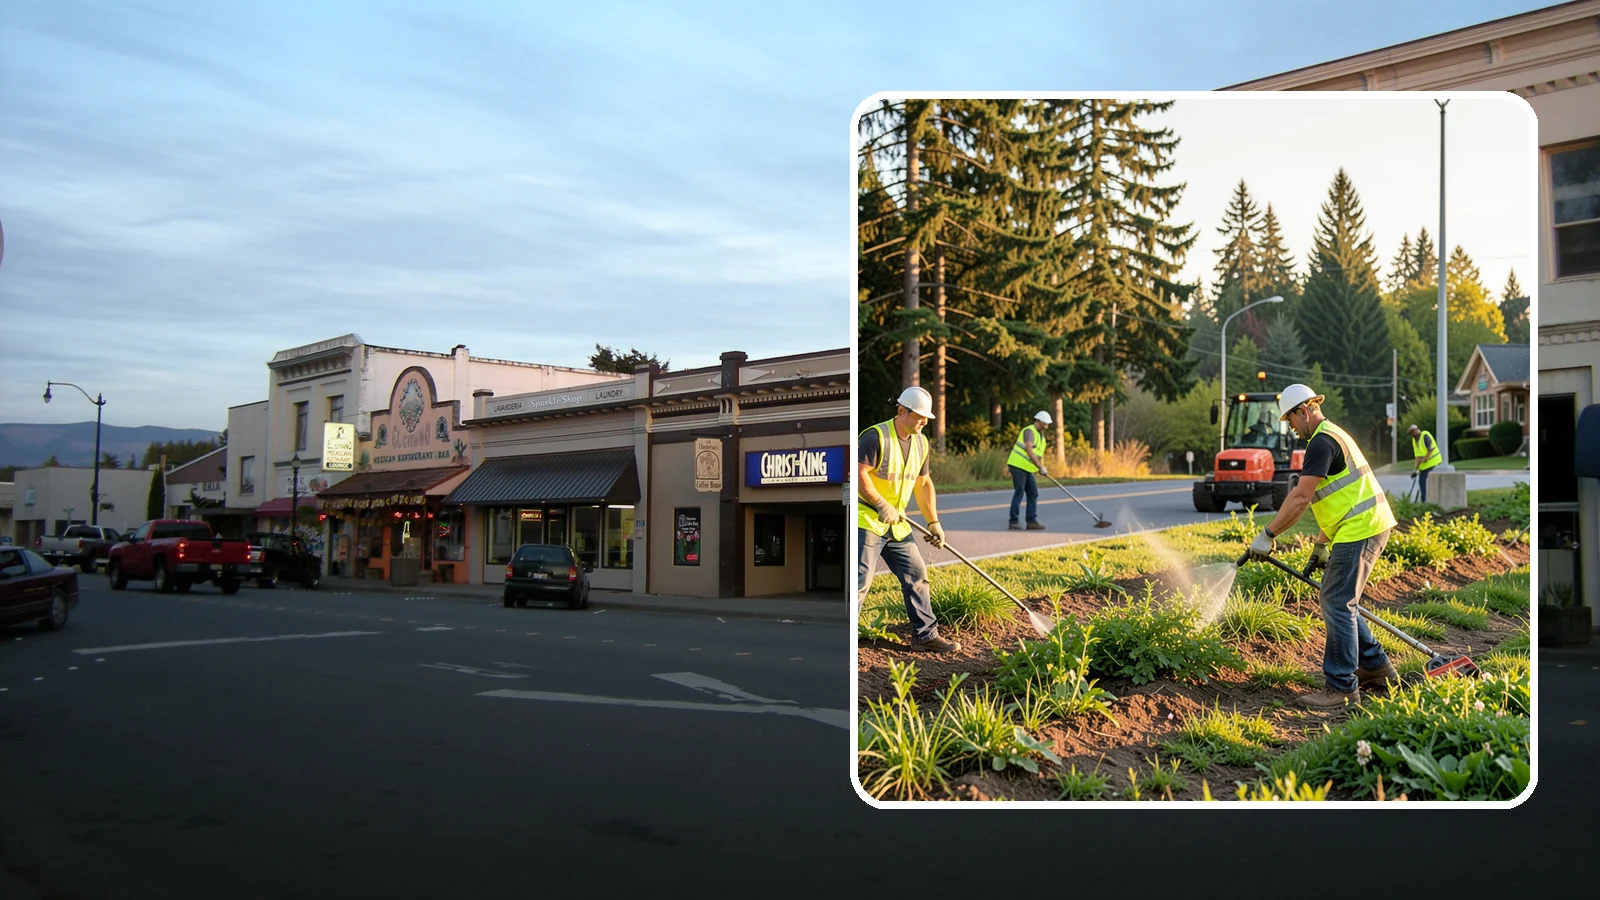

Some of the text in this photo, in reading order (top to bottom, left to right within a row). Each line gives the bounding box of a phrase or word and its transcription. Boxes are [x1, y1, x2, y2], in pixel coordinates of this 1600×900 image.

[561, 394, 583, 405] Shop
[595, 389, 623, 400] LAUNDRY
[493, 402, 522, 412] LAVANDERIA
[373, 455, 396, 464] MEXICAN
[397, 451, 433, 462] RESTAURANT
[437, 450, 450, 459] BAR
[761, 450, 827, 478] CHRIST KING
